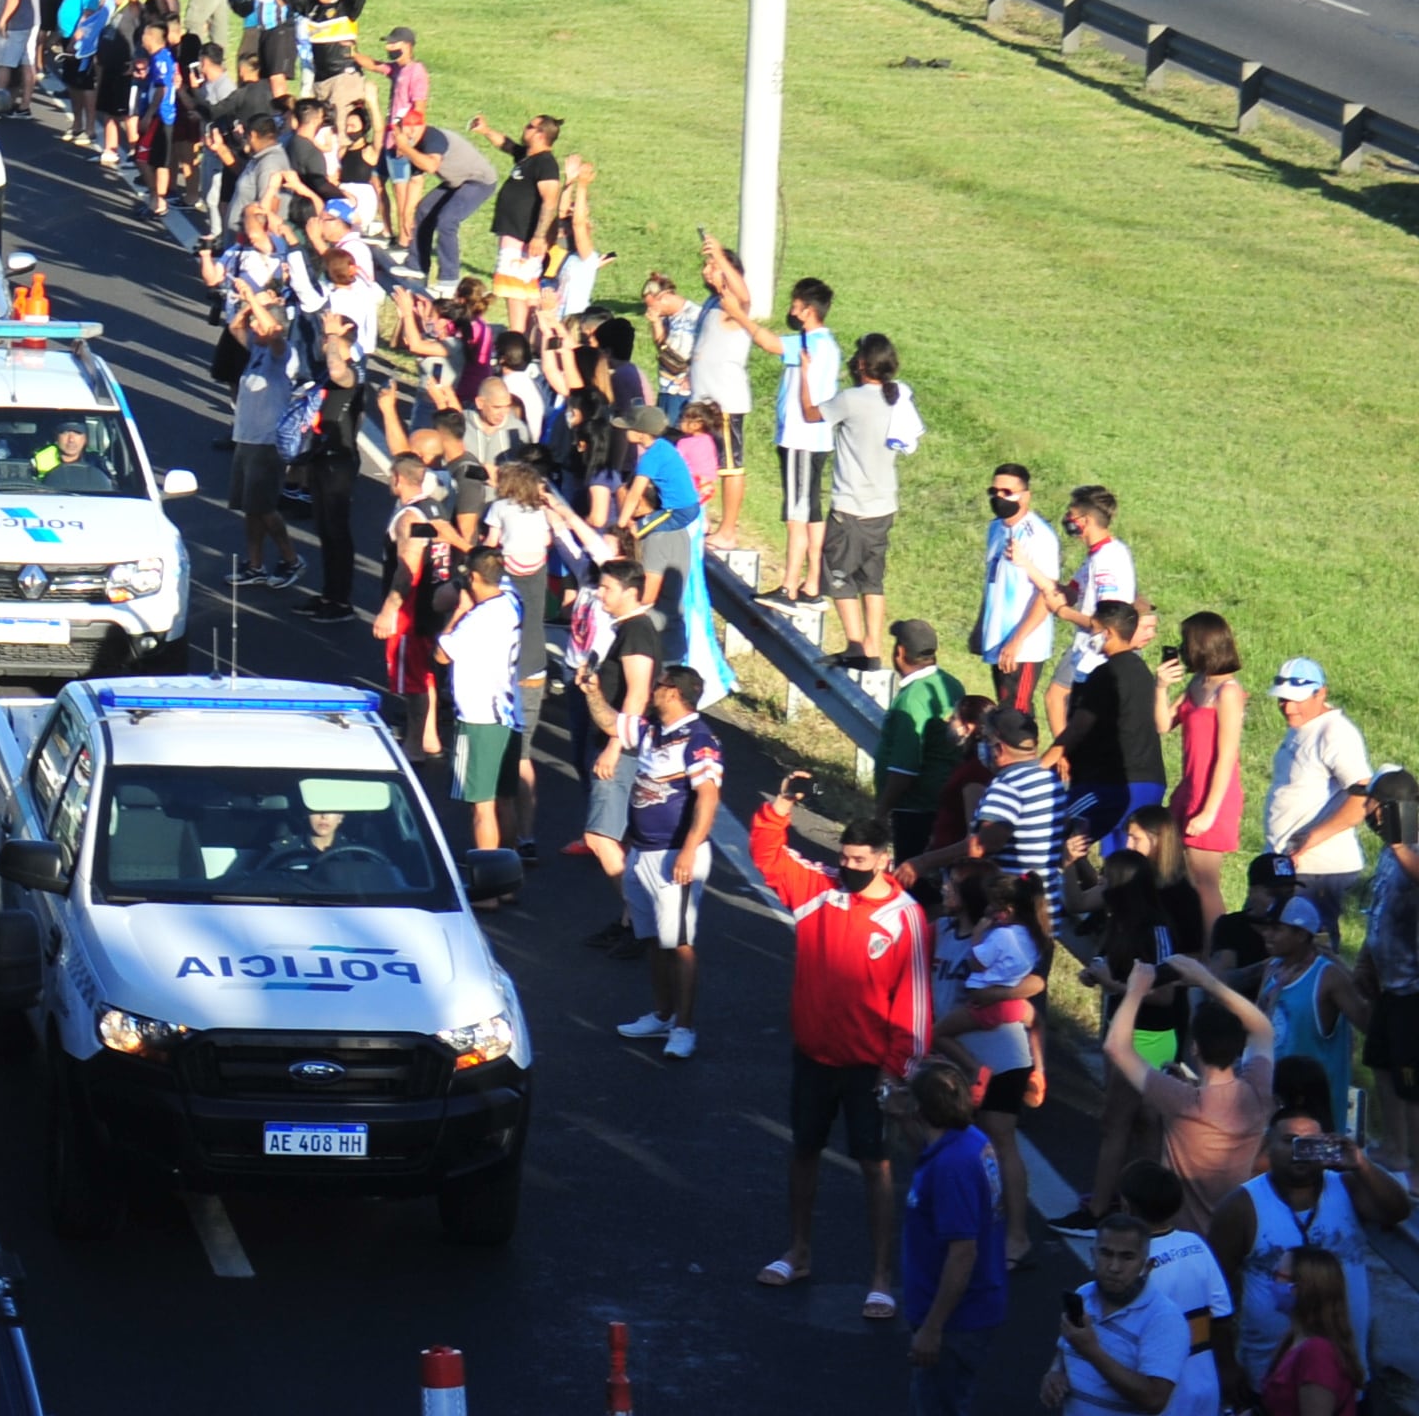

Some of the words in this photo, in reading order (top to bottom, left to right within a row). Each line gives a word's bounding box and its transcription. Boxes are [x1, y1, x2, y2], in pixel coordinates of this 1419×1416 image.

[269, 1134, 292, 1151] AE
[298, 1134, 332, 1152] 408
[338, 1135, 362, 1152] HH
